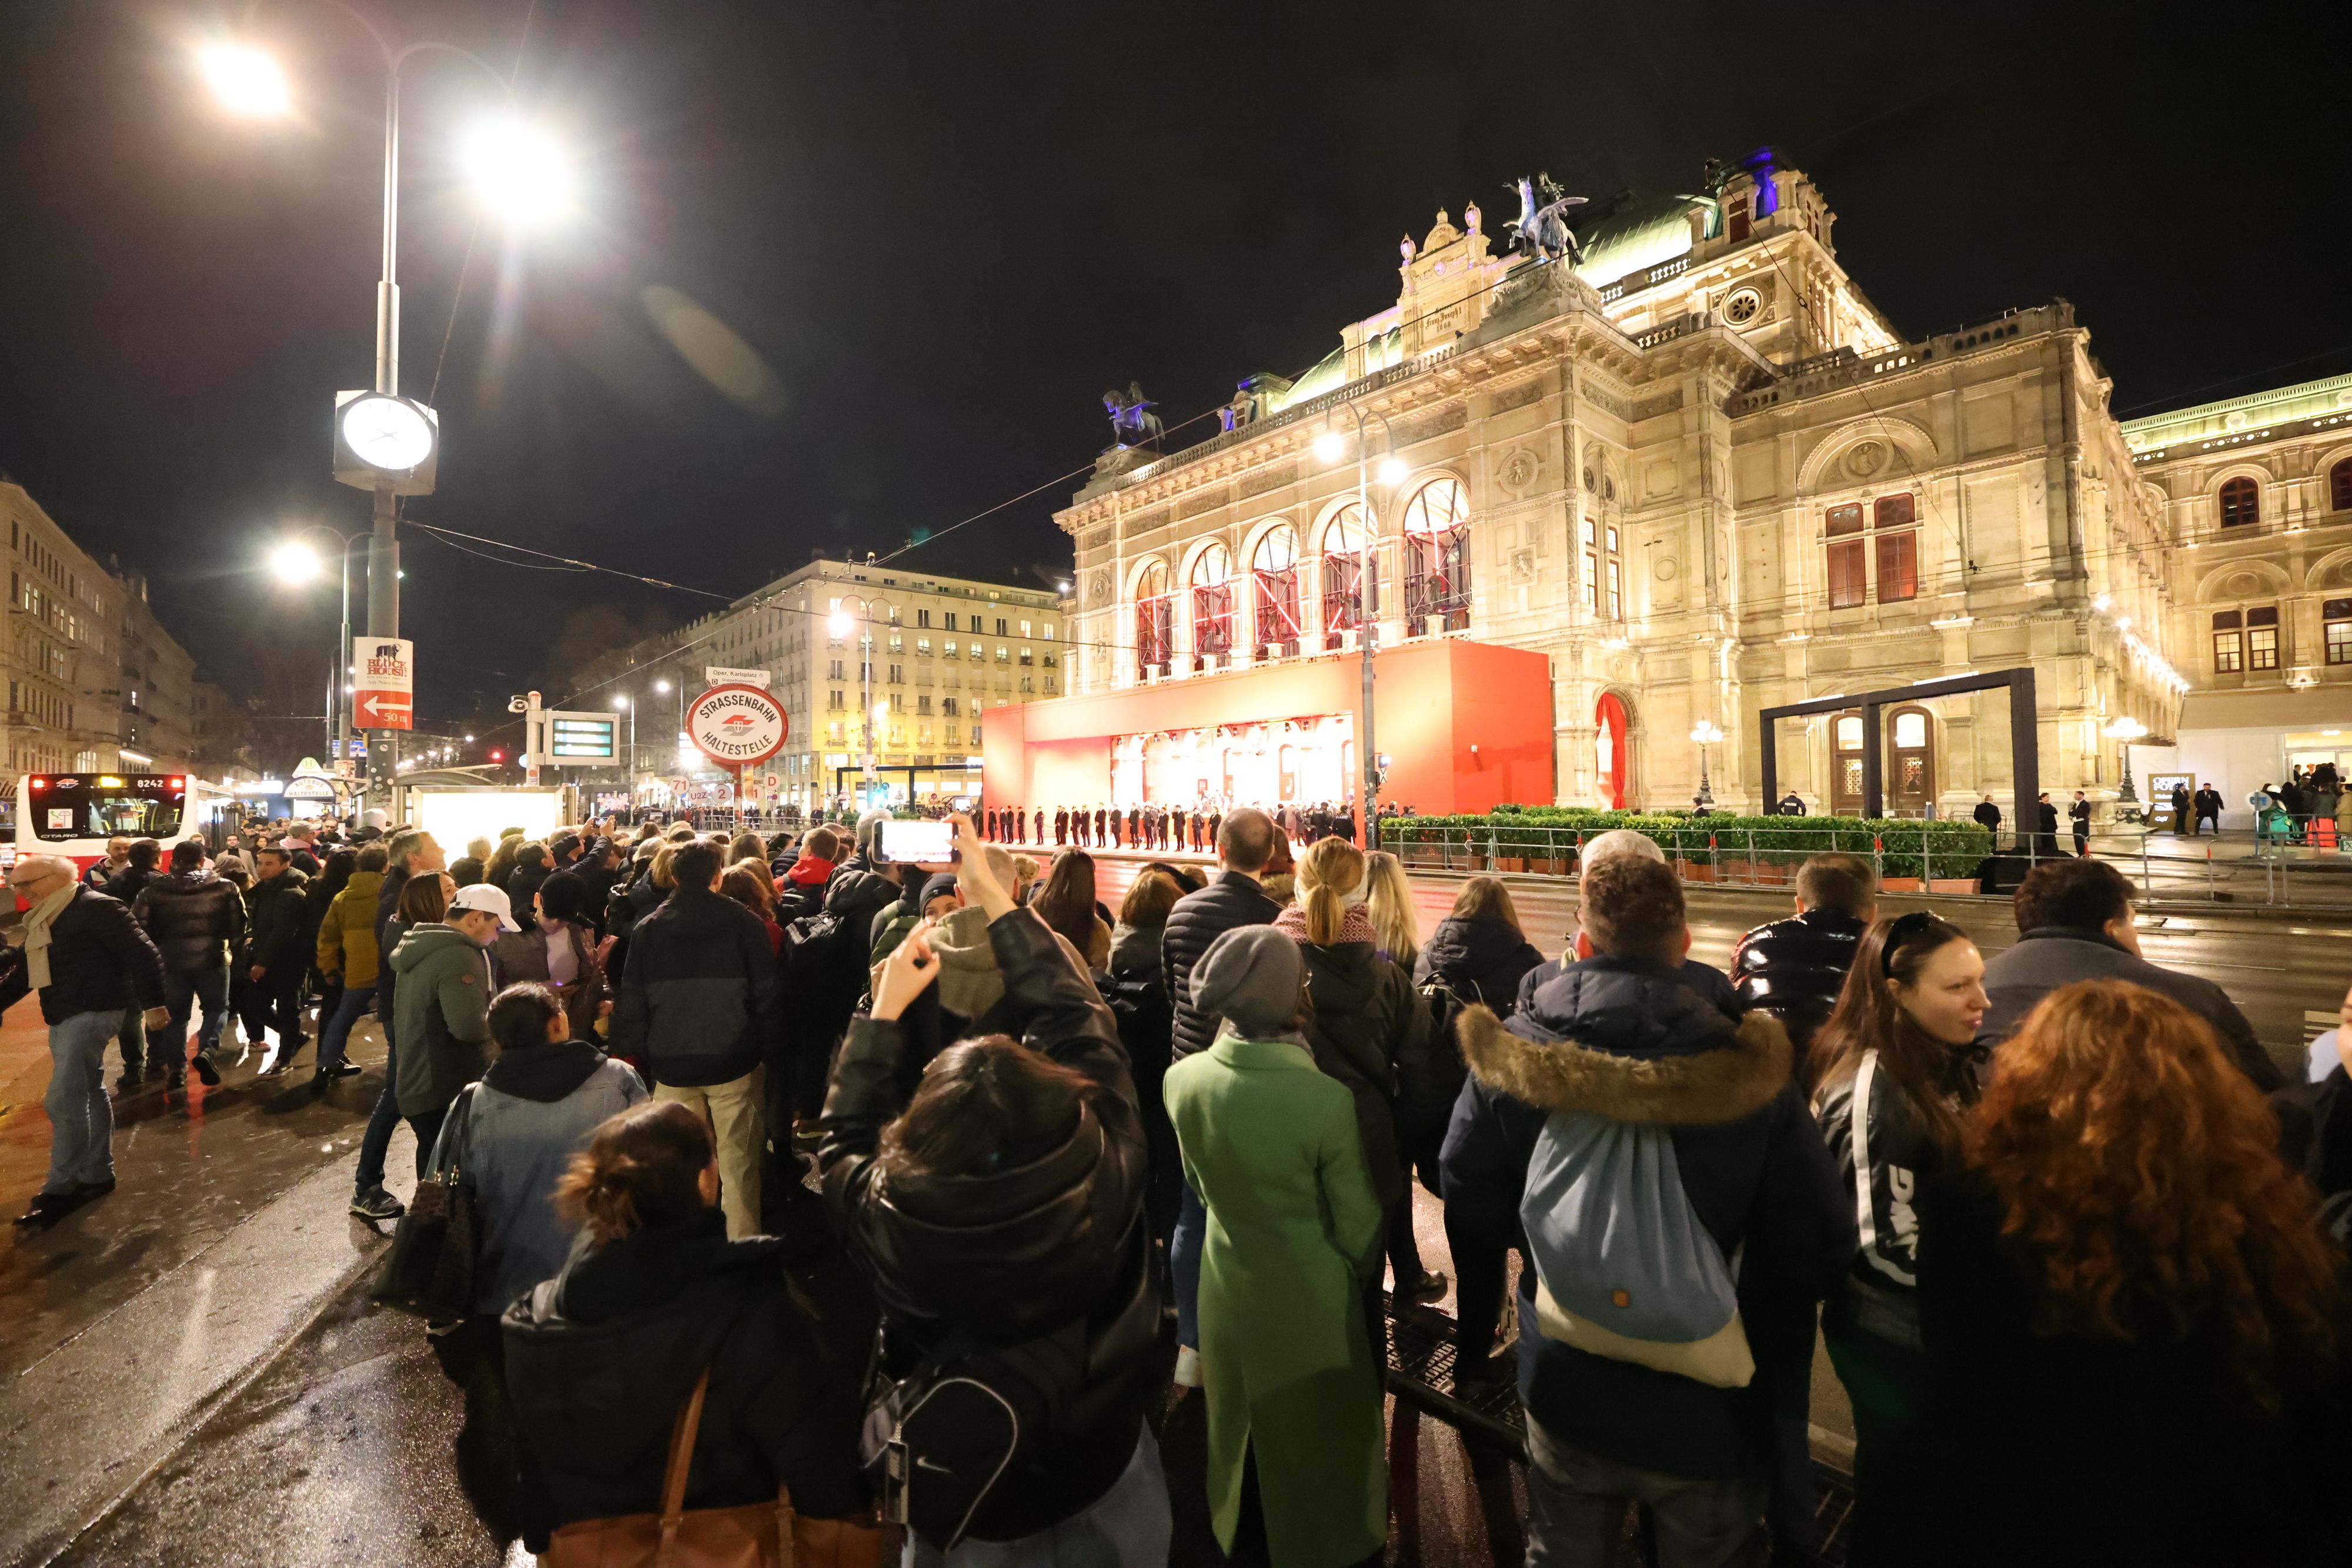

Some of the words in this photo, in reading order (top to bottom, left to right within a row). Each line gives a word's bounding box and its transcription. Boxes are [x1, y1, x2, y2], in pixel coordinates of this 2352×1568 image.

[367, 659, 407, 669] BLOCK
[367, 667, 407, 677] HOUSE
[699, 695, 777, 723] STRASSENBAHN
[383, 713, 397, 722] 50
[702, 731, 773, 755] HALTESTELLE
[137, 780, 163, 788] 8242
[295, 779, 324, 787] AUTOBUS
[673, 780, 687, 791] 71
[768, 776, 776, 786] D
[690, 792, 707, 800] U2Z
[718, 788, 726, 799] 2
